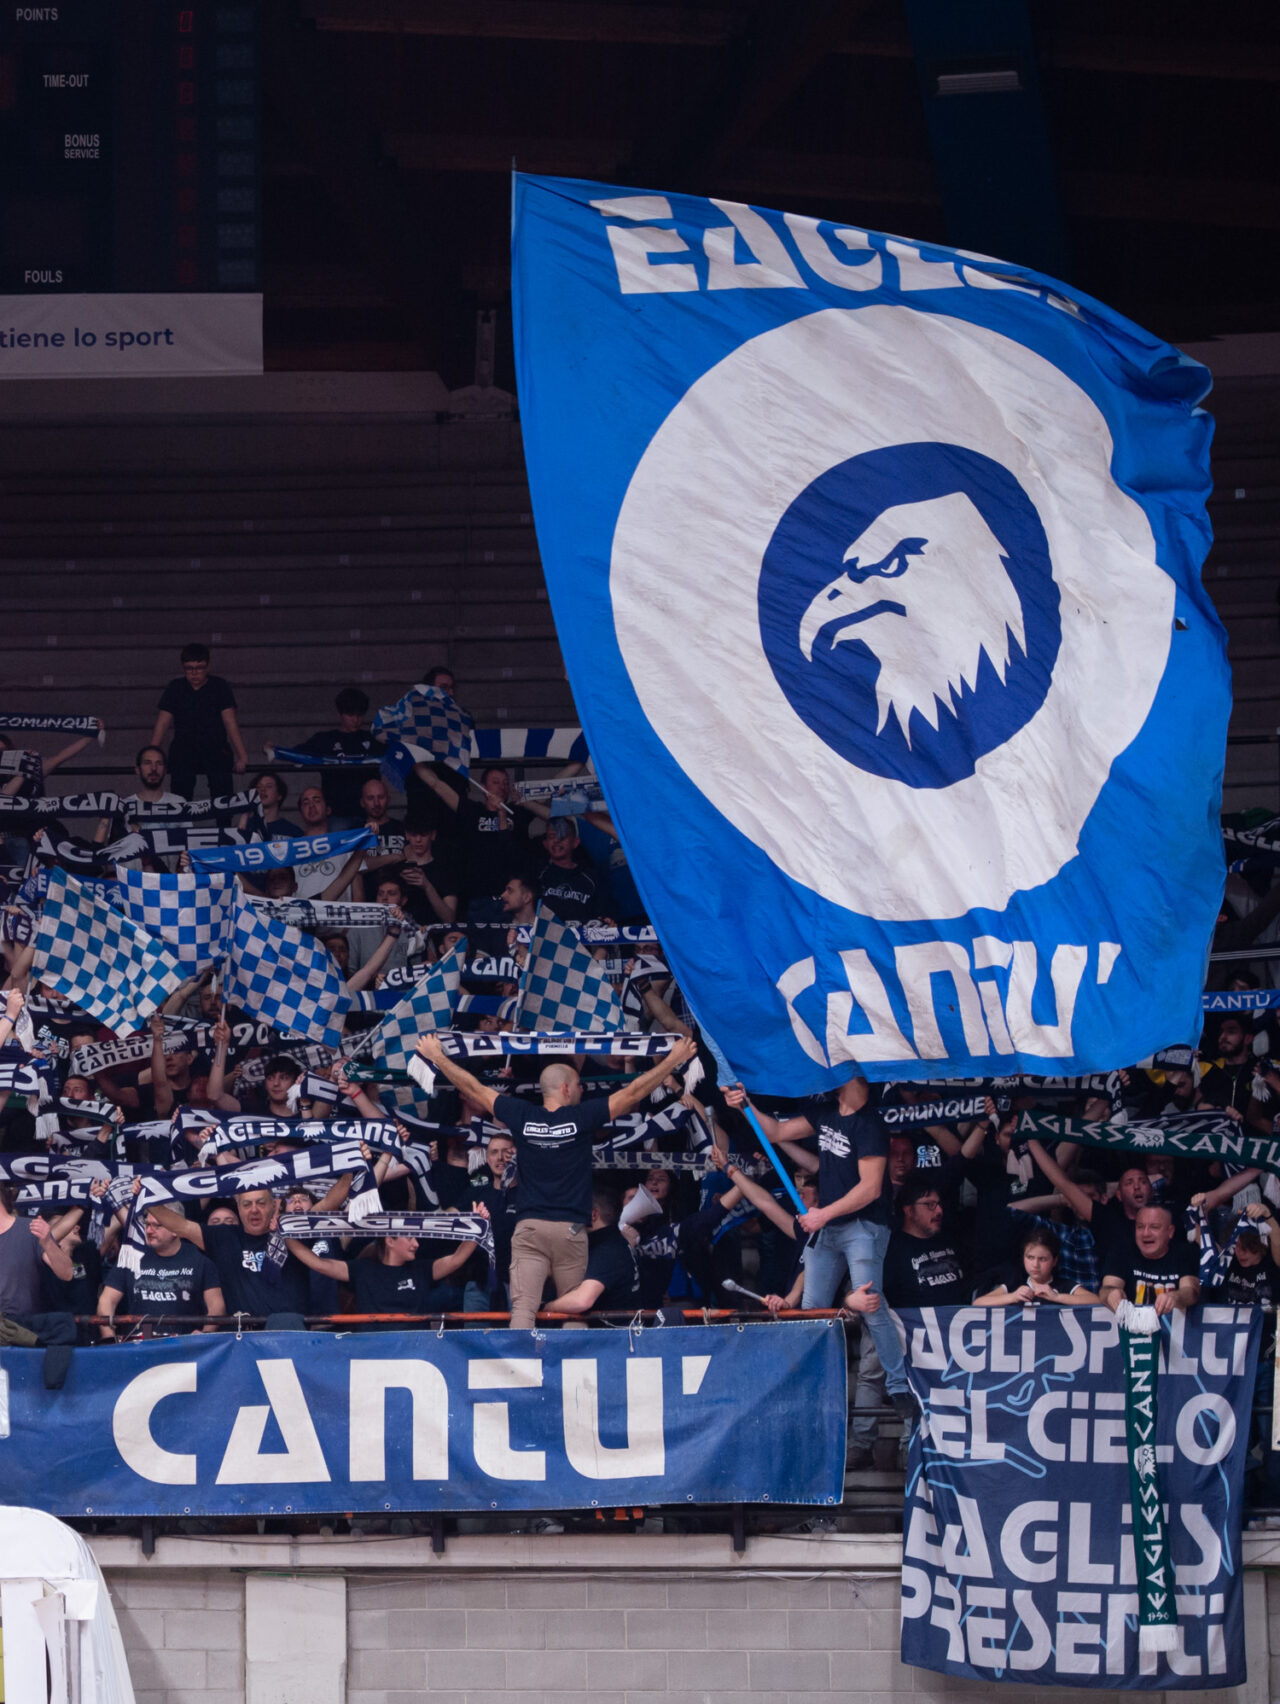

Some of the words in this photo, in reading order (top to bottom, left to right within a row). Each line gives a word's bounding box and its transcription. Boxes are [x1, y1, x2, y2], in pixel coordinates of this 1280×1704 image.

[16, 8, 59, 21] POINTS
[43, 74, 89, 87] TIME-OUT
[64, 134, 100, 147] BONUS
[64, 148, 100, 159] SERVICE
[24, 269, 63, 283] FOULS
[74, 325, 97, 348] lo
[104, 325, 174, 354] sport
[234, 848, 265, 866] 19
[290, 837, 332, 859] 36
[878, 1095, 986, 1124] OMUNQUE
[898, 1306, 1037, 1373] AGLI
[1054, 1307, 1253, 1377] SPLTI
[1140, 1479, 1170, 1612] EAGLES
